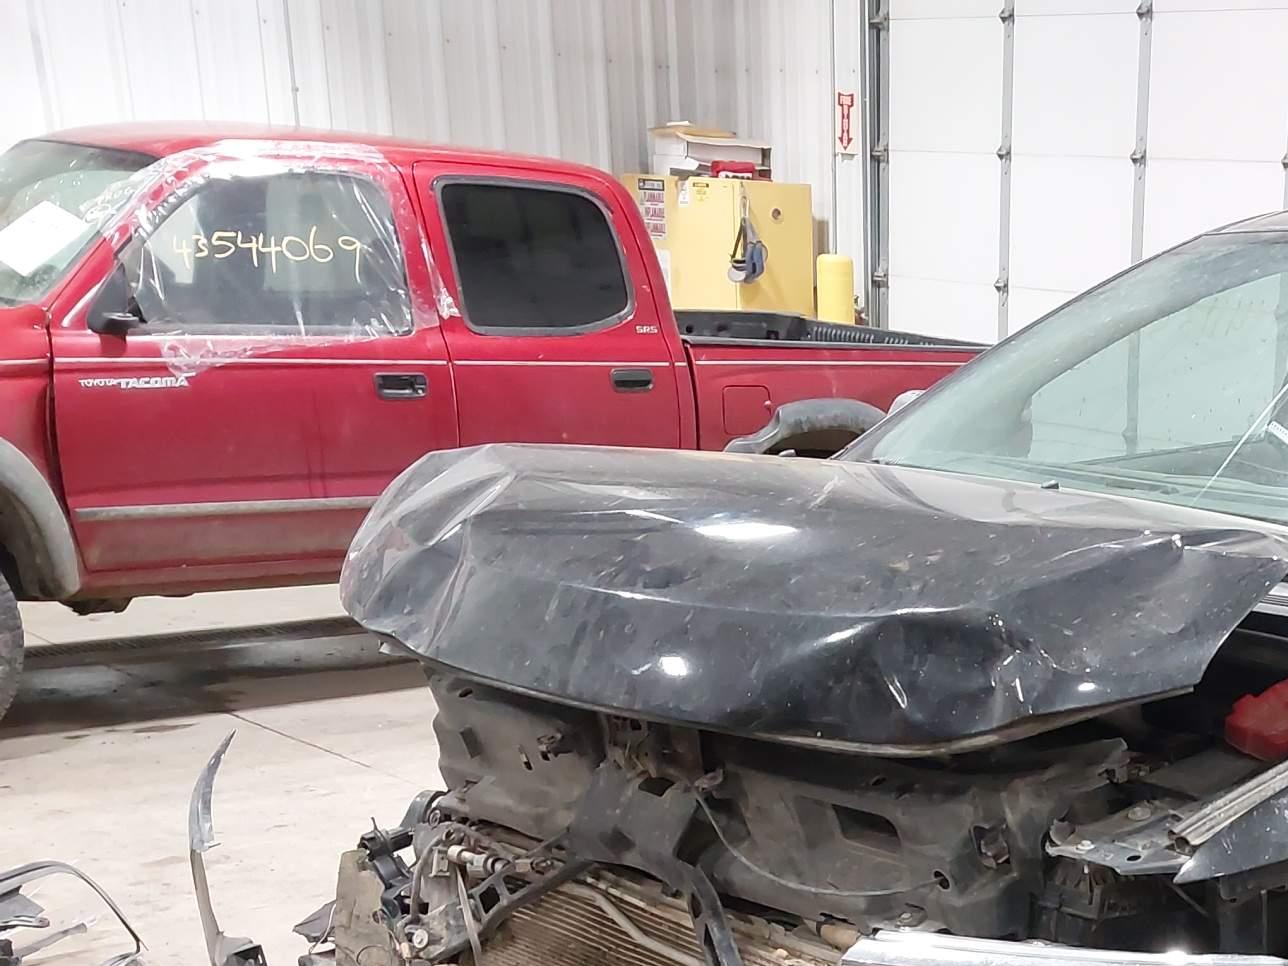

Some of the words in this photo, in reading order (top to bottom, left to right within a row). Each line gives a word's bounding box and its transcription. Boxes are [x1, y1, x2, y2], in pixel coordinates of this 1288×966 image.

[173, 226, 361, 284] 43544069
[78, 378, 117, 387] TOYOTA
[117, 374, 192, 389] TACOMA
